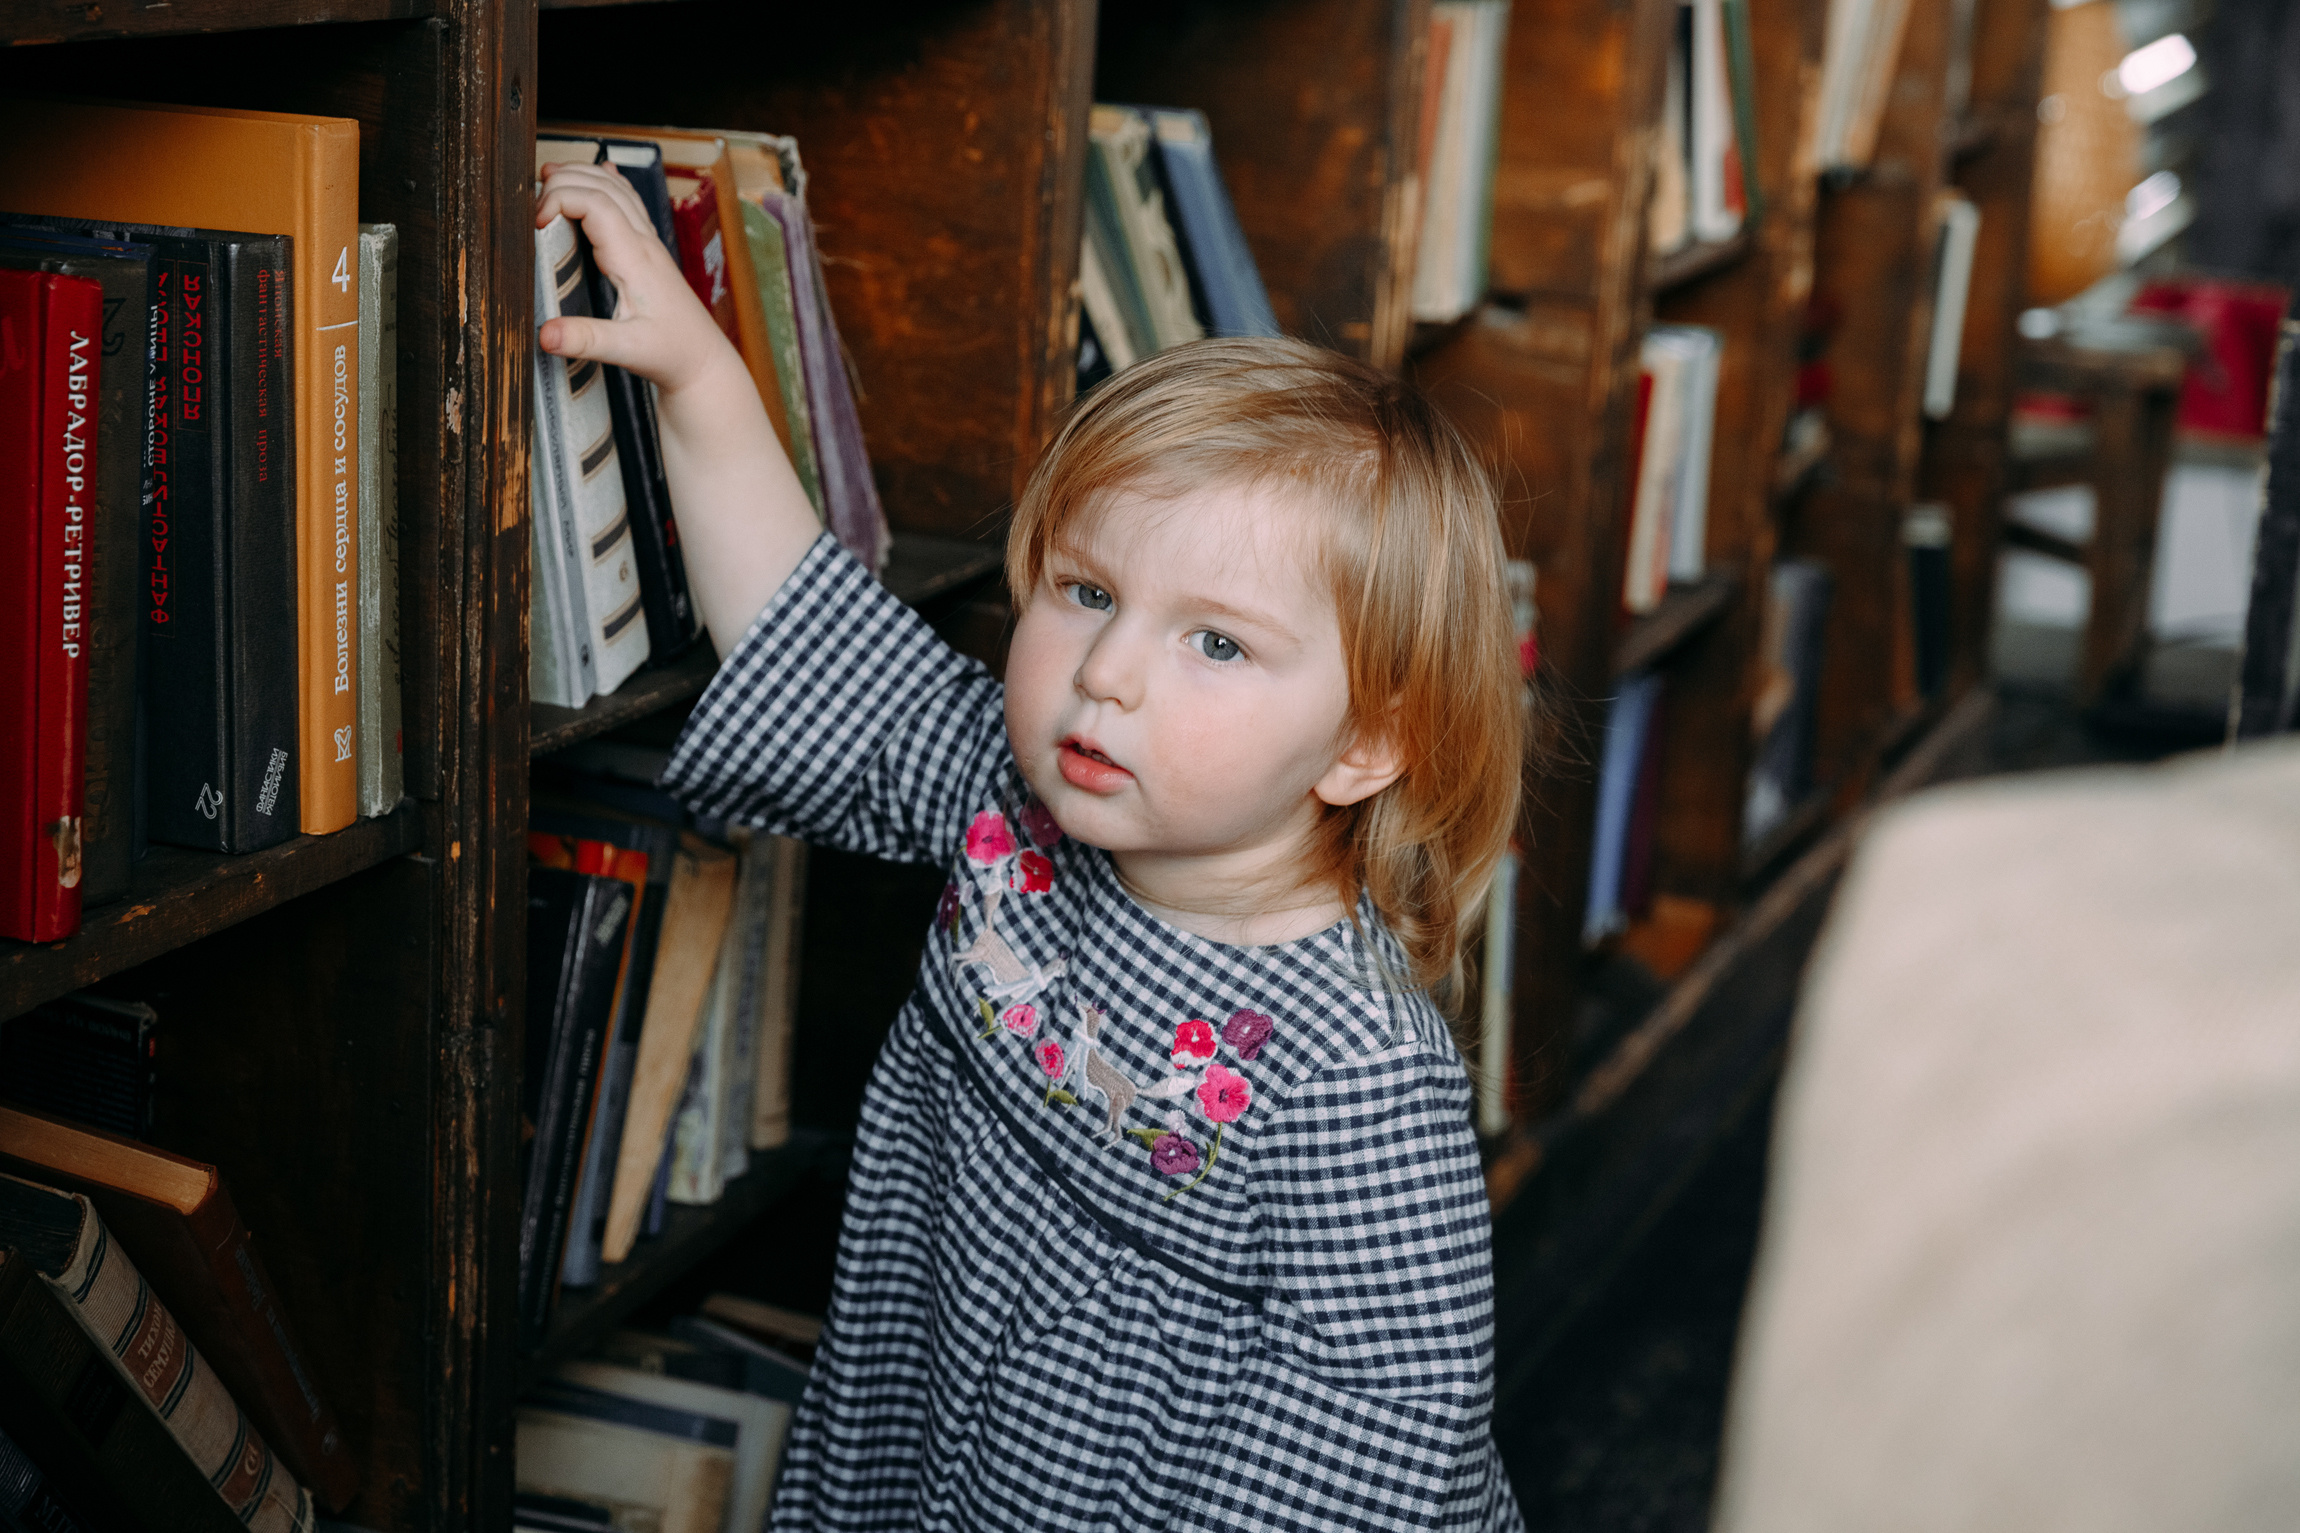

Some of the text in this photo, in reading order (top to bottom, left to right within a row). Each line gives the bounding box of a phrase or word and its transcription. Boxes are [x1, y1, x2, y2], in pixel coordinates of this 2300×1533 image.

[274, 269, 286, 358] Японская
[331, 246, 351, 293] 4
[182, 274, 203, 420] ЯПОНСКАЯ
[256, 269, 270, 483] фантастическая проза
[62, 329, 90, 659] ЛАБРАДОР-РЕТРИВЕР
[333, 344, 350, 696] Болезни сердца и сосудов
[255, 747, 280, 812] ФАНТАСТИКИ
[265, 751, 288, 816] БИБЛИОТЕКА
[138, 1302, 162, 1358] ТИХОН
